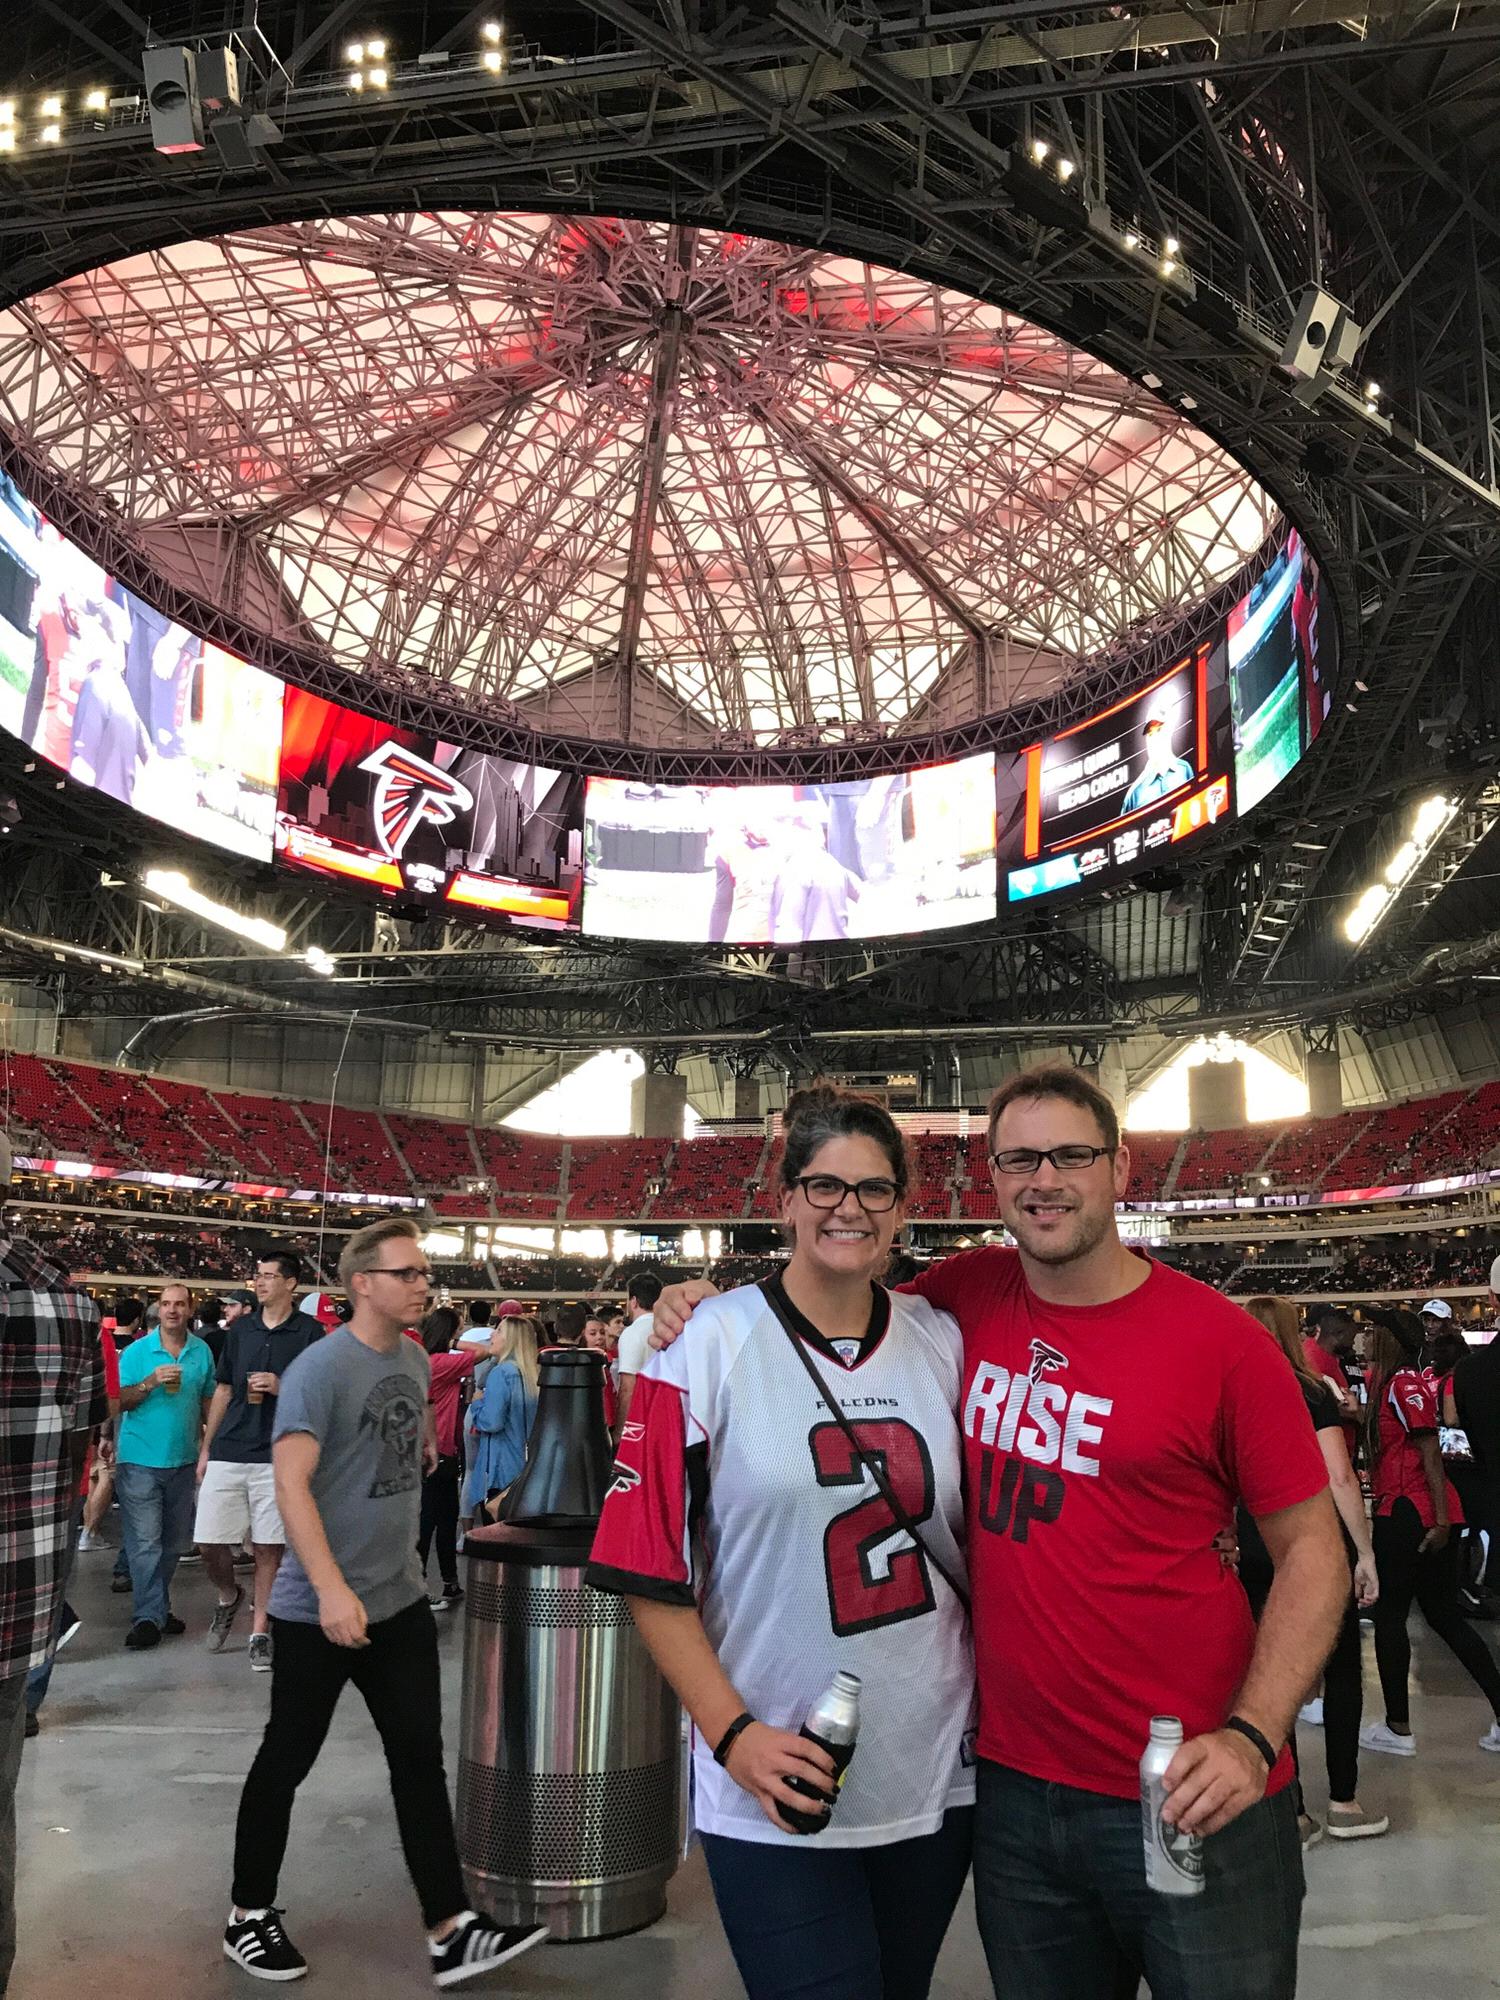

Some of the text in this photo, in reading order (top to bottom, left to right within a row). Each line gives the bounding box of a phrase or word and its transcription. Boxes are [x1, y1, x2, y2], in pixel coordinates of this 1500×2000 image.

[816, 1397, 899, 1410] FLCONS
[964, 1360, 1114, 1477] RISE
[808, 1417, 937, 1637] 2
[978, 1450, 1066, 1544] UP
